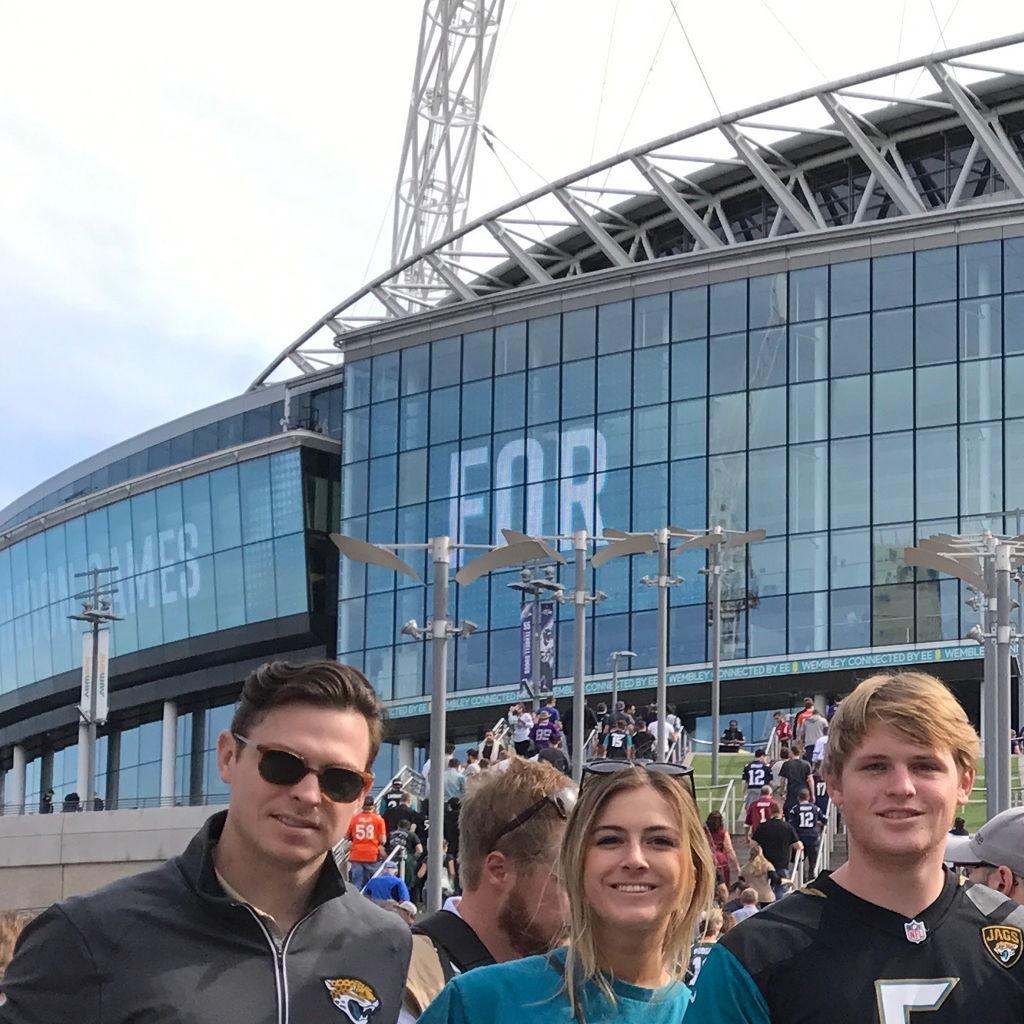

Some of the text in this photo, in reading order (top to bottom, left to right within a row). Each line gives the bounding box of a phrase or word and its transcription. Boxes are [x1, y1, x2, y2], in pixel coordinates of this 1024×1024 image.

[448, 427, 608, 564] FOR
[801, 651, 933, 670] WEMBLEY CONNECTED BY EE
[944, 645, 984, 659] WEMBLE
[668, 670, 710, 684] WEMBLEY
[719, 664, 766, 679] ONNECTED
[748, 769, 766, 786] 12
[799, 811, 814, 828] 12
